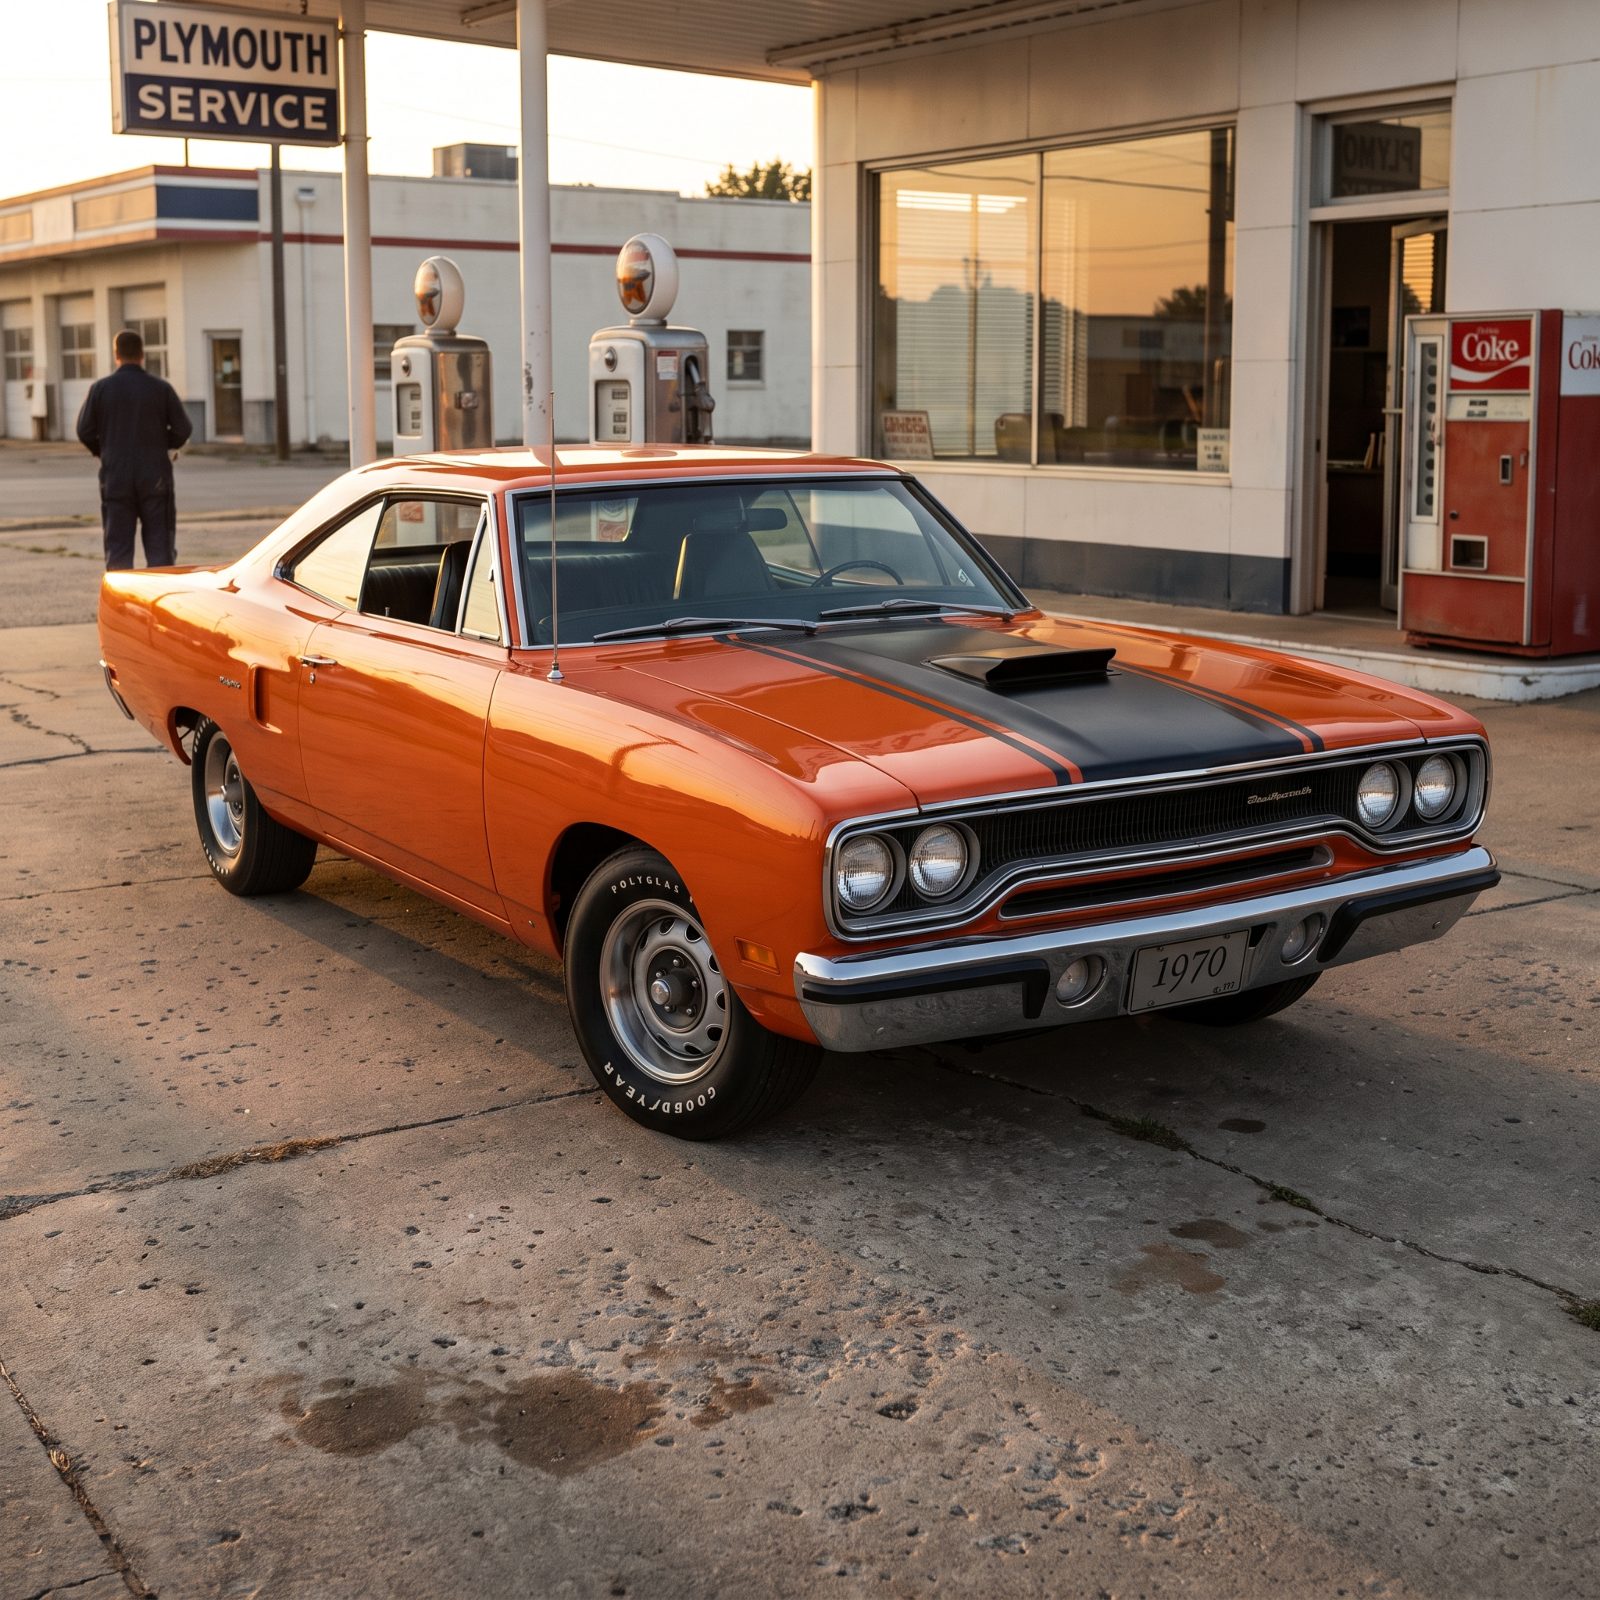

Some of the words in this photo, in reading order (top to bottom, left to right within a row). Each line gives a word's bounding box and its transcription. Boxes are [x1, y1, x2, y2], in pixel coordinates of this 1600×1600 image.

[134, 18, 328, 75] PLYMOUTH
[138, 84, 328, 130] SERVICE
[1461, 333, 1519, 362] Coke
[1152, 946, 1227, 993] 1970
